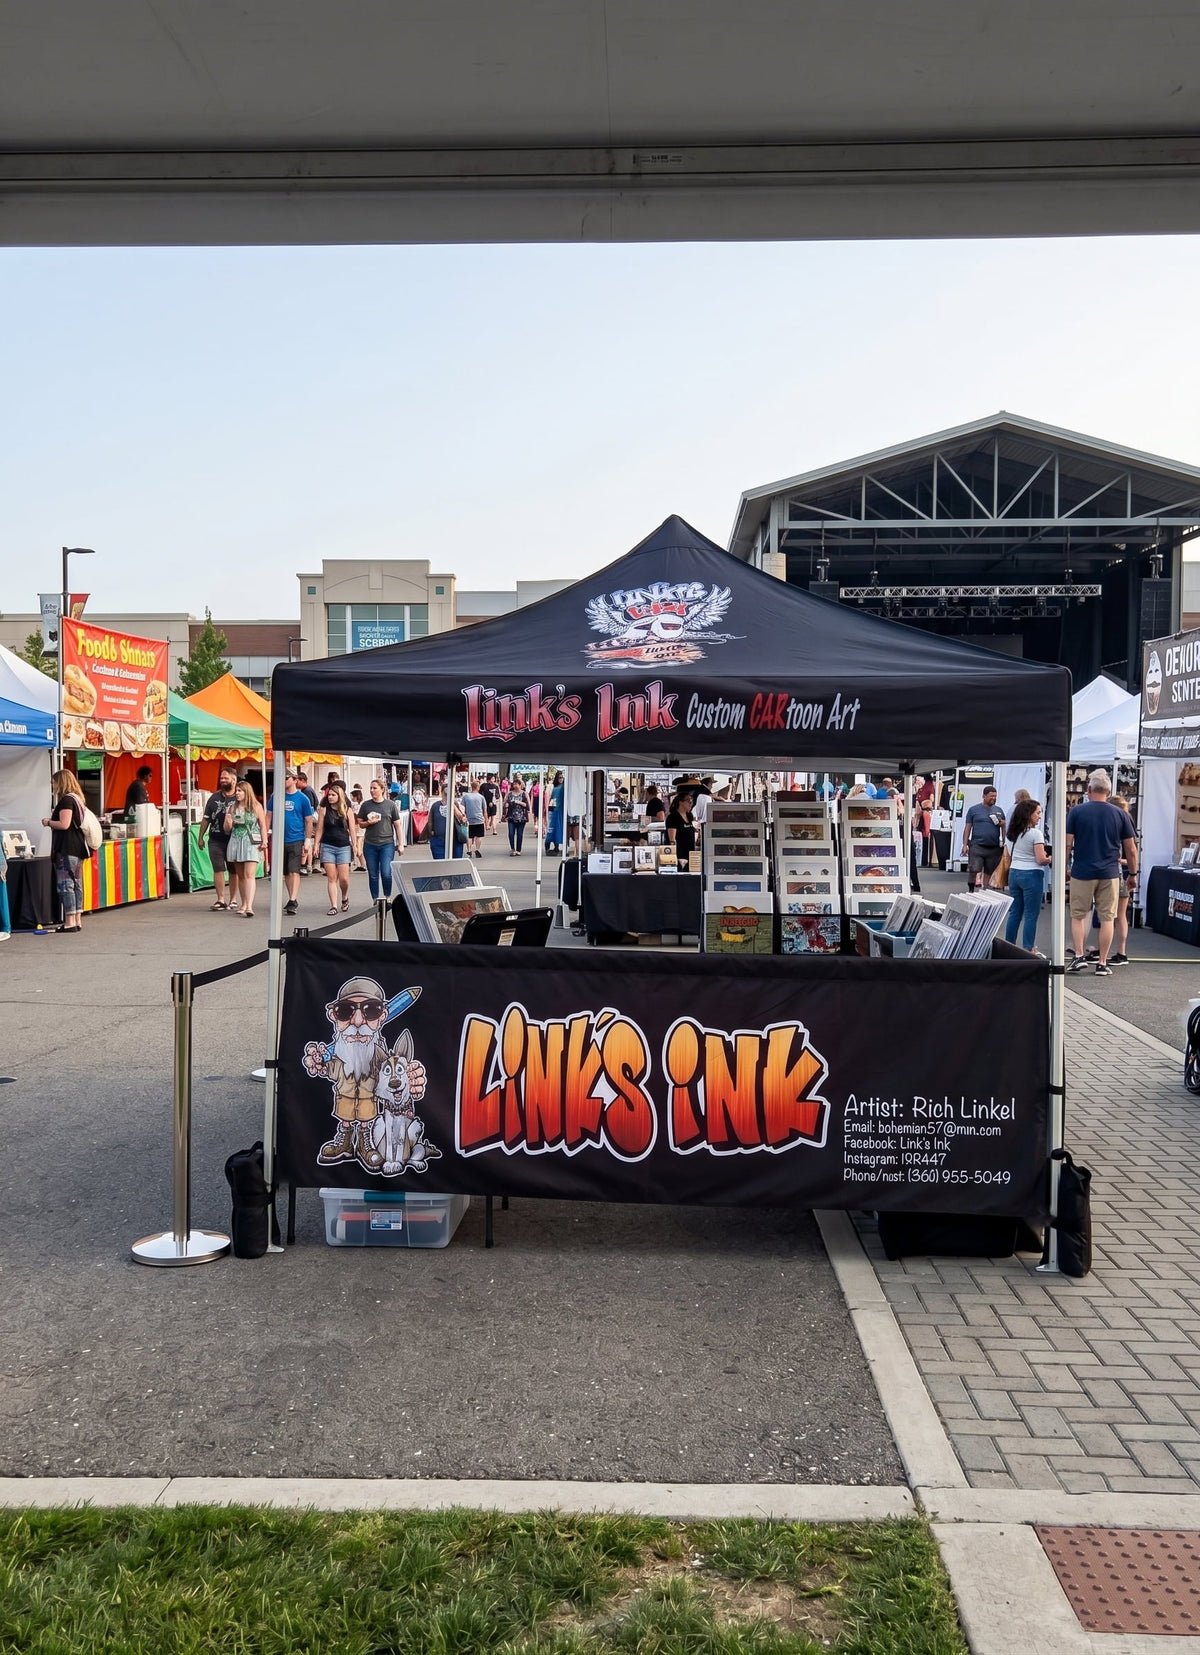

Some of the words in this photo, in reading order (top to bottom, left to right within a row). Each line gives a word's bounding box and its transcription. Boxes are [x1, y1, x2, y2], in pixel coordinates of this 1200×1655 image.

[461, 683, 581, 742] Link's
[595, 680, 679, 742] Ink
[686, 692, 746, 730] Custom
[750, 692, 823, 730] CARtoon
[826, 692, 861, 730] Art
[844, 1094, 904, 1117] Artist:
[912, 1096, 954, 1119] Rich
[961, 1096, 1015, 1120] Linkel
[844, 1119, 875, 1133] Email:
[844, 1135, 897, 1149] Facebook:
[900, 1136, 931, 1150] Link's
[934, 1136, 951, 1151] Ink
[844, 1151, 898, 1168] Instagram:
[907, 1168, 939, 1184] (360)
[942, 1170, 1011, 1184] 955-5049
